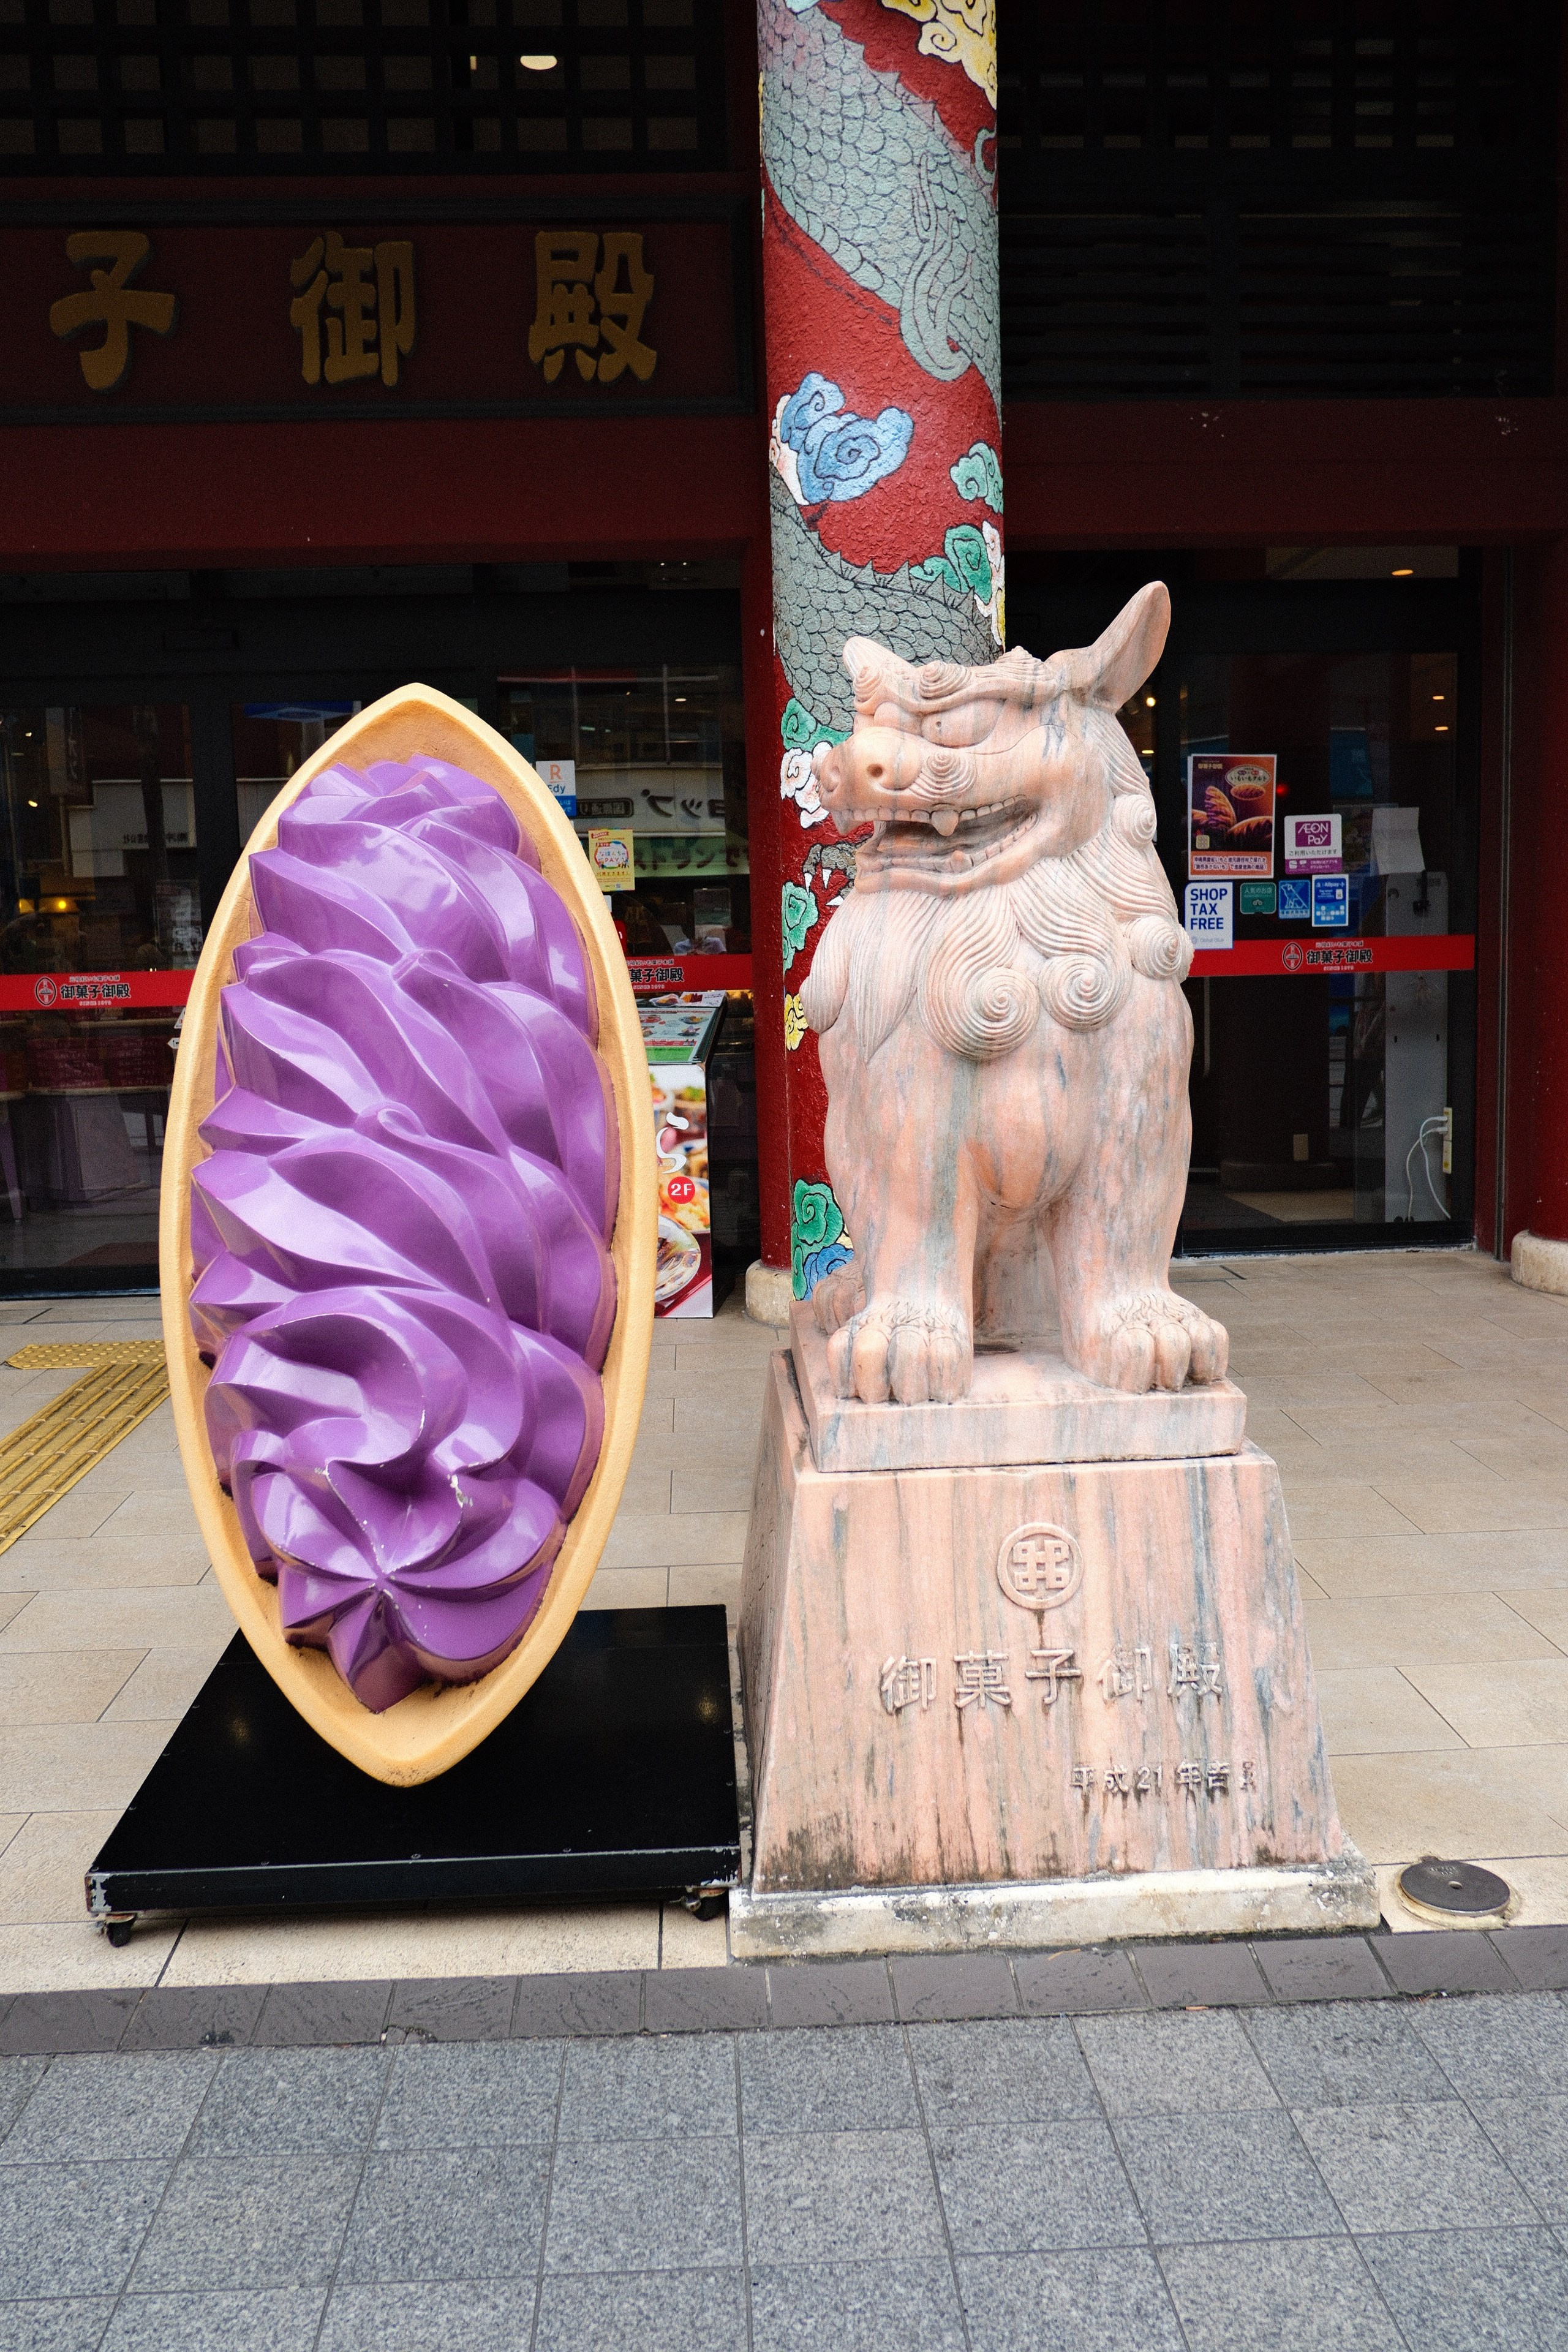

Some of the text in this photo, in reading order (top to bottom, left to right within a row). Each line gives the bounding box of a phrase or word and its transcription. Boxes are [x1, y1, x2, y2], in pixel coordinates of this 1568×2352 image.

[49, 230, 658, 390] 子御殿
[1190, 888, 1227, 900] SHOP
[1190, 903, 1218, 915] TAX
[1190, 918, 1224, 930] FREE
[1306, 949, 1373, 964] 御菓子御殿
[61, 983, 131, 999] 御菓子御殿
[671, 1183, 692, 1196] 2F
[880, 1642, 1224, 1713] 御菓子御殿
